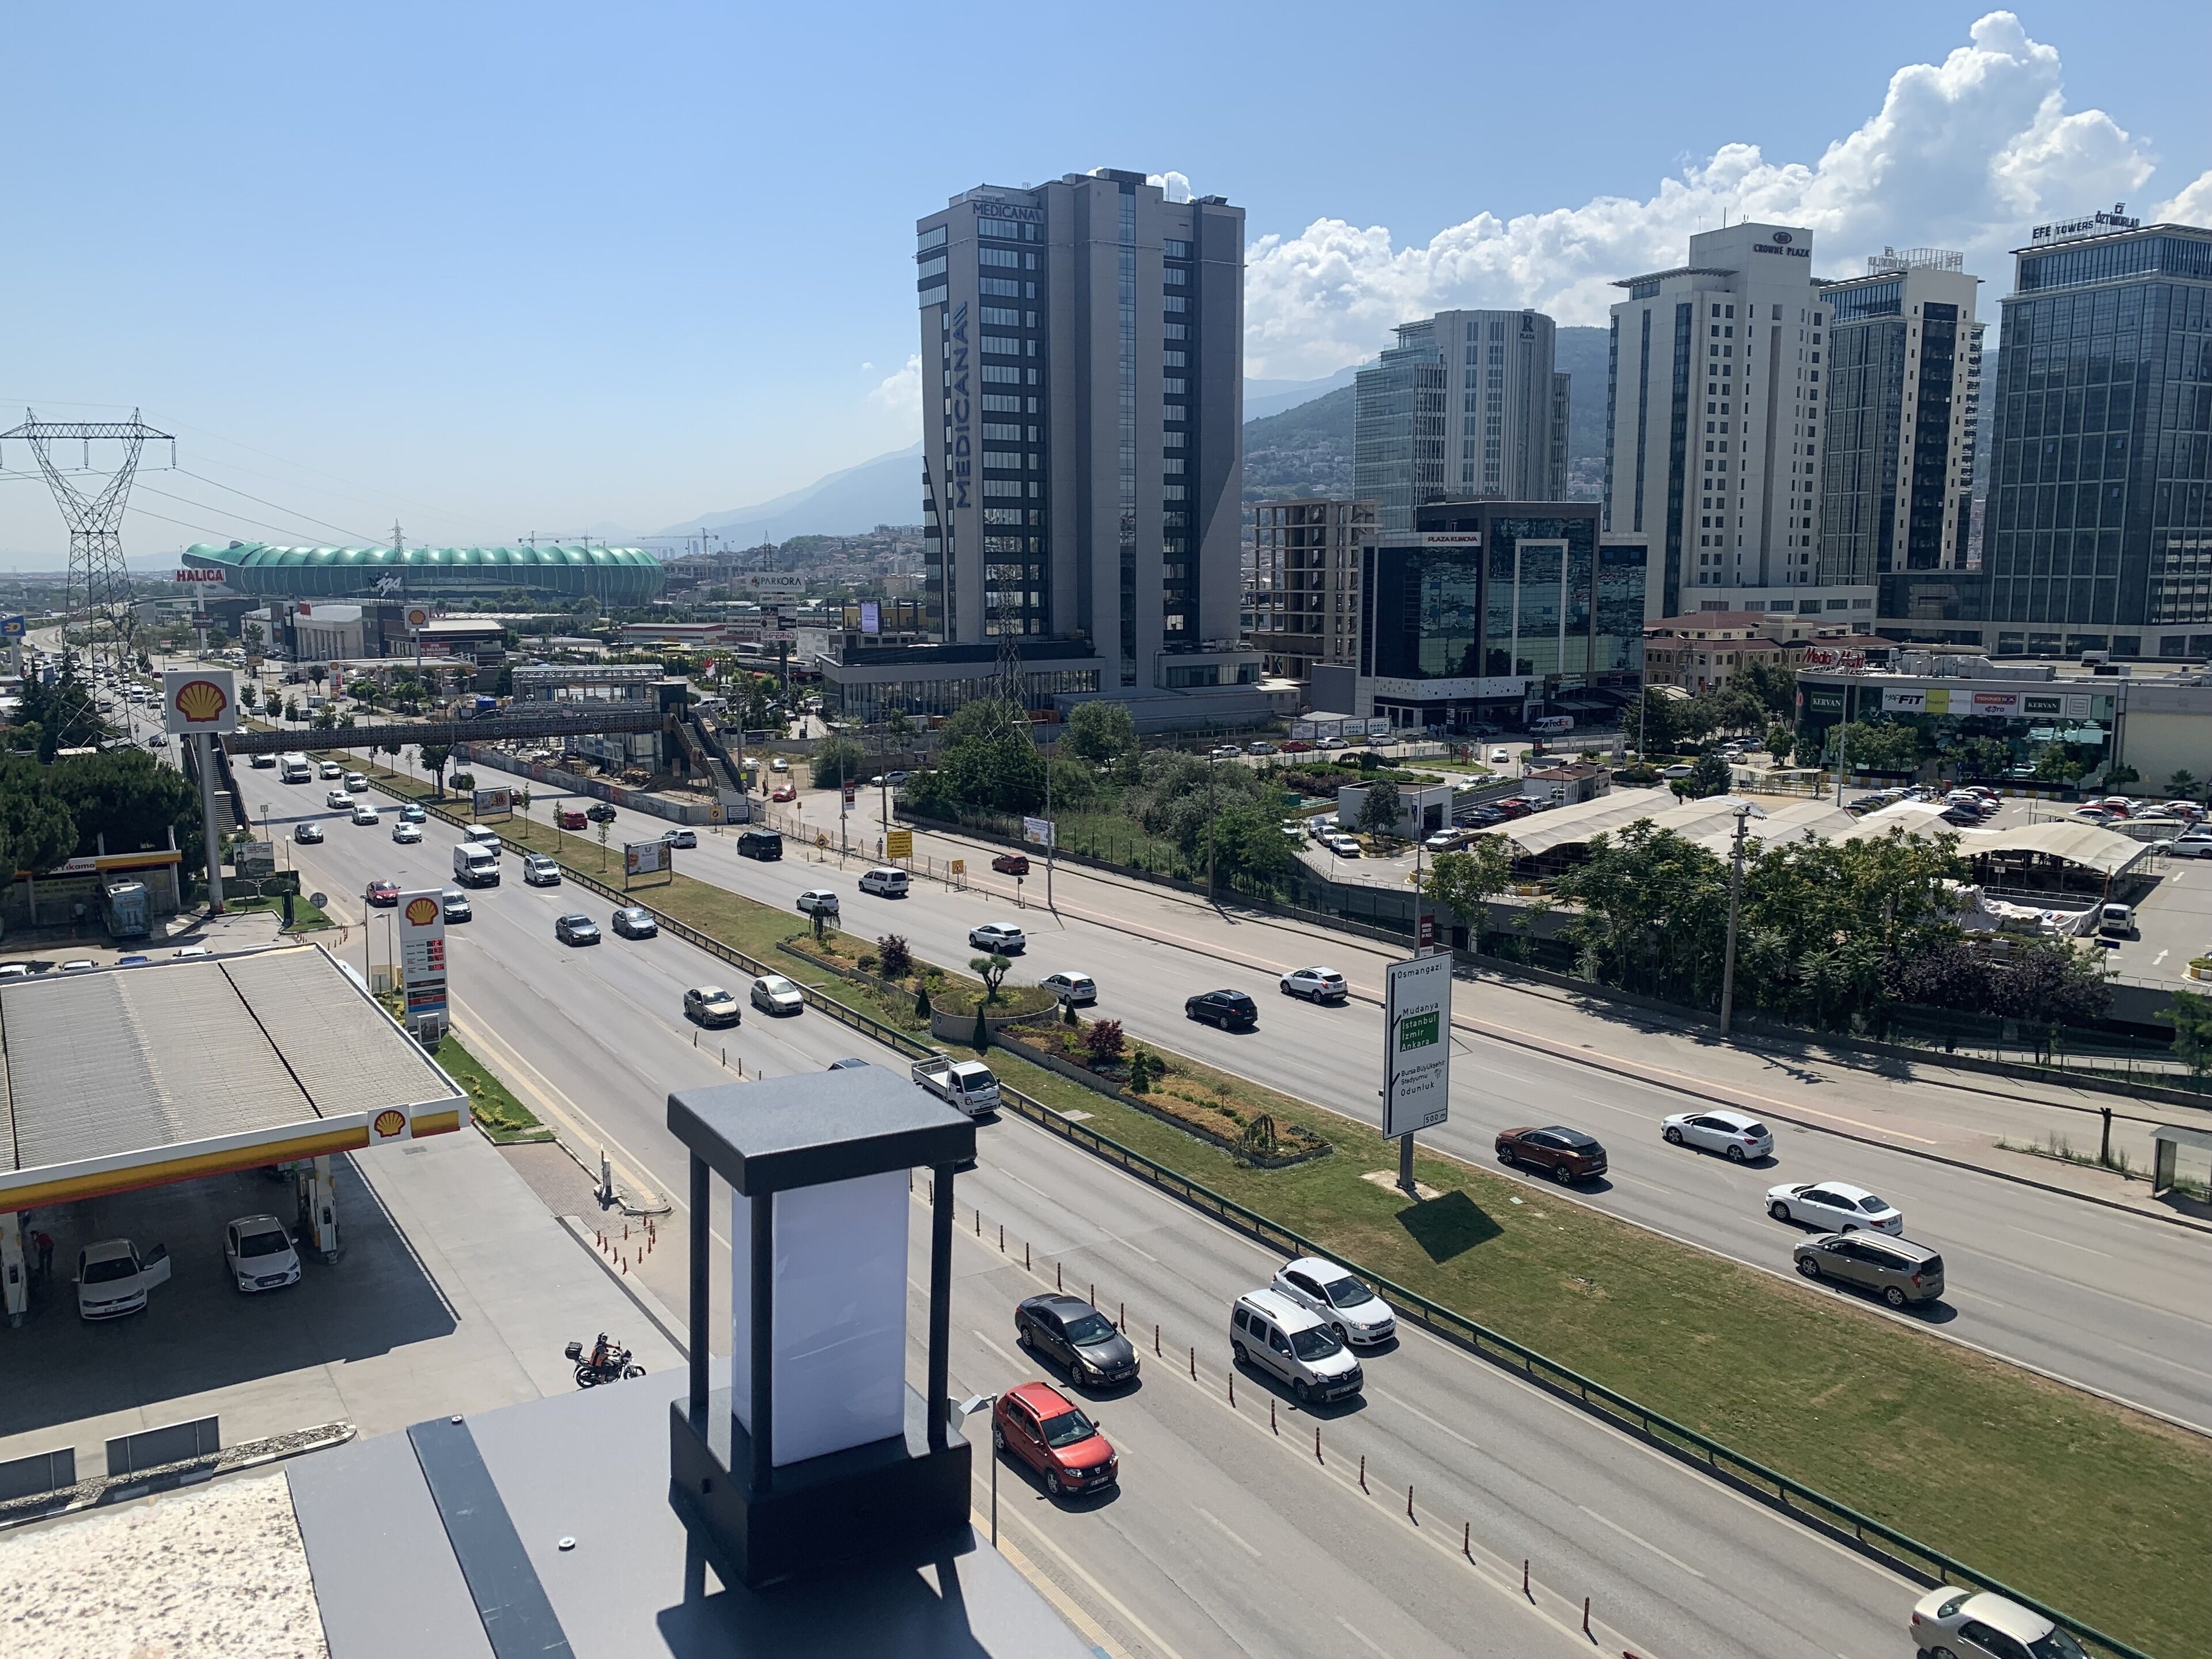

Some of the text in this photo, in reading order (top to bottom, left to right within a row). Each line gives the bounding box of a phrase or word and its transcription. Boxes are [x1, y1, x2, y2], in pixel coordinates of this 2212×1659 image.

[973, 203, 1035, 221] MEDICANA
[2033, 221, 2093, 238] EFE TOWERS
[1753, 244, 1810, 257] CROWNE PLAZA
[1522, 315, 1533, 332] R
[953, 320, 971, 508] MEDICANA
[761, 577, 801, 585] PARKORA
[1802, 647, 1831, 664] Media
[1813, 698, 1841, 707] KERVAN
[1549, 718, 1569, 727] FedEx
[1397, 963, 1442, 979] Osmangazi
[1403, 1002, 1438, 1016] Mudanya
[1402, 1014, 1436, 1029] İstanbul
[1402, 1029, 1424, 1040] İzmir
[1401, 1039, 1430, 1051] Ankara
[1401, 1068, 1416, 1077] Bursa
[1401, 1074, 1428, 1085] Stadyumu
[1401, 1081, 1434, 1096] Odunluk
[1426, 1113, 1438, 1123] 500
